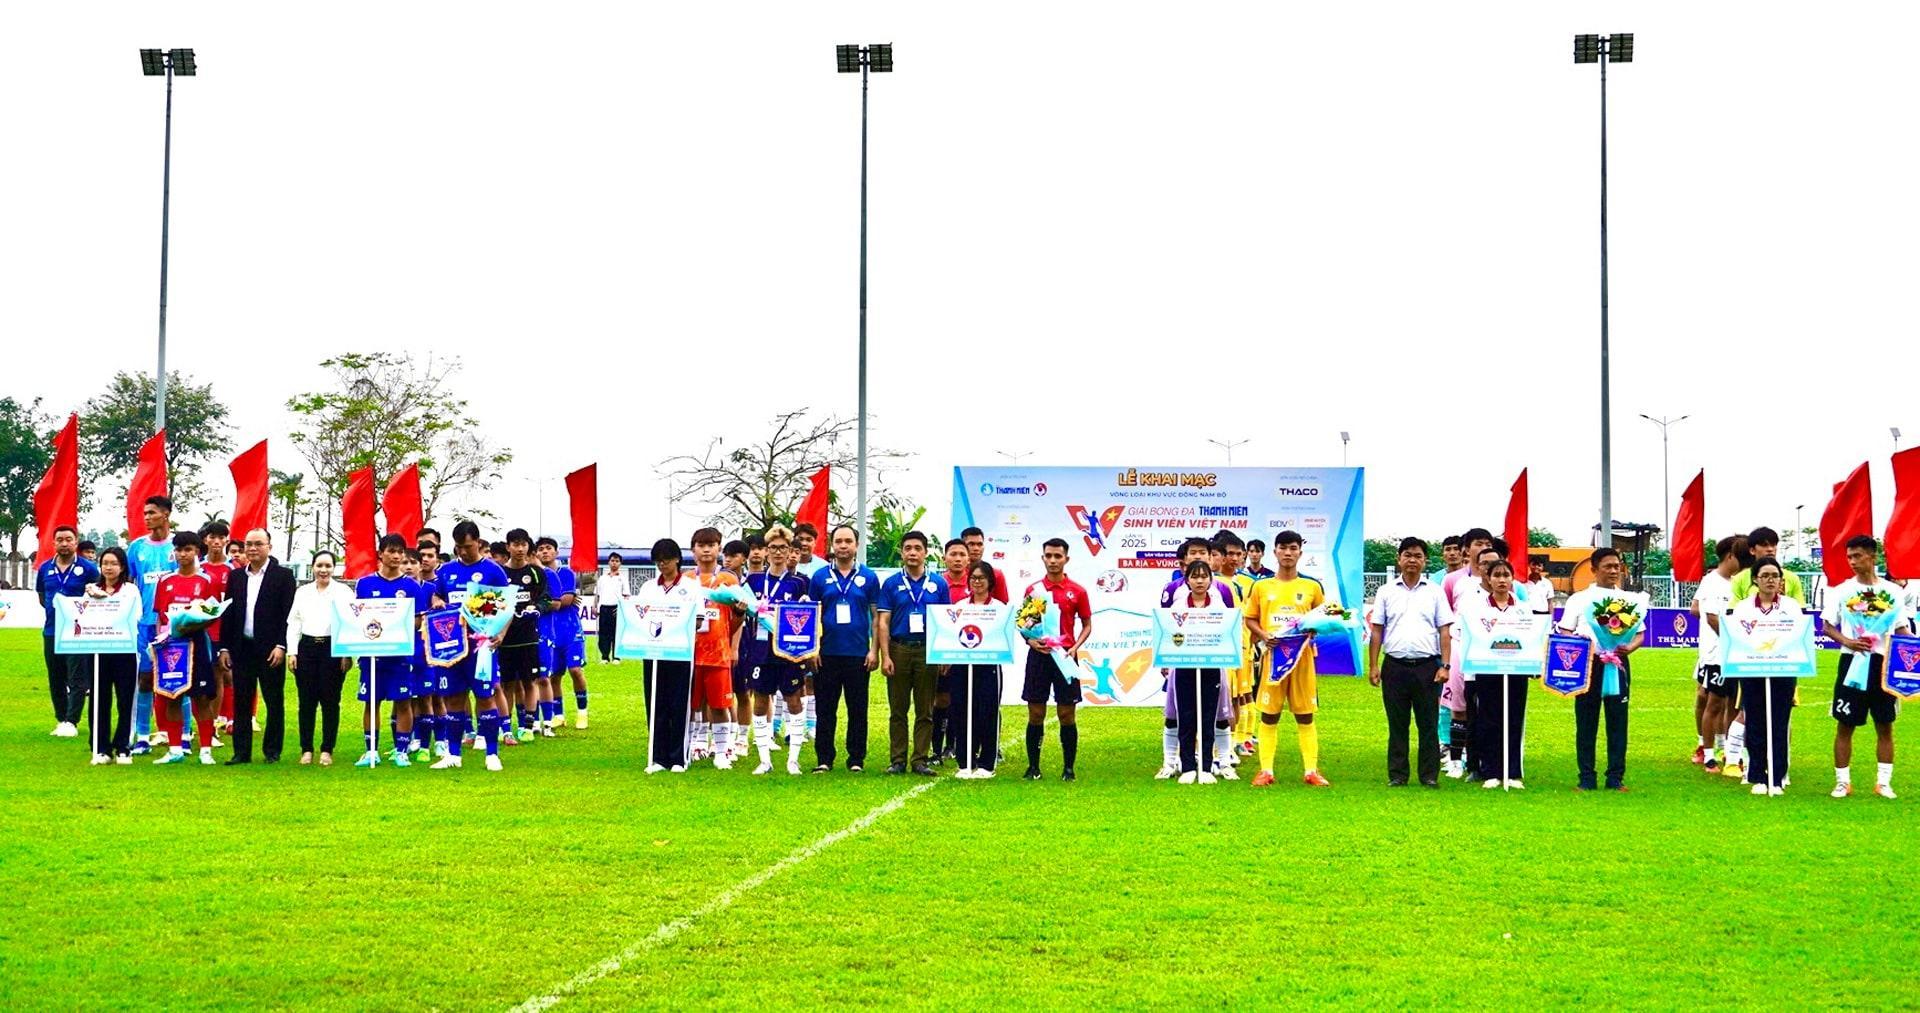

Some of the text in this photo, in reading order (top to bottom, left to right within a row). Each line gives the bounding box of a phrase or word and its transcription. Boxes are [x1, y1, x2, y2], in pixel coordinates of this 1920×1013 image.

[1118, 467, 1216, 489] LỄ KHAI MẠC
[1279, 488, 1318, 496] THACO
[1199, 506, 1227, 516] THANH
[1123, 517, 1248, 529] SINH VIÊN VIỆT NAM
[1121, 538, 1147, 548] 2025
[1160, 537, 1181, 546] CÚP
[1657, 635, 1675, 643] THE
[752, 666, 760, 680] 8
[1710, 672, 1726, 687] 20
[1836, 699, 1851, 716] 24
